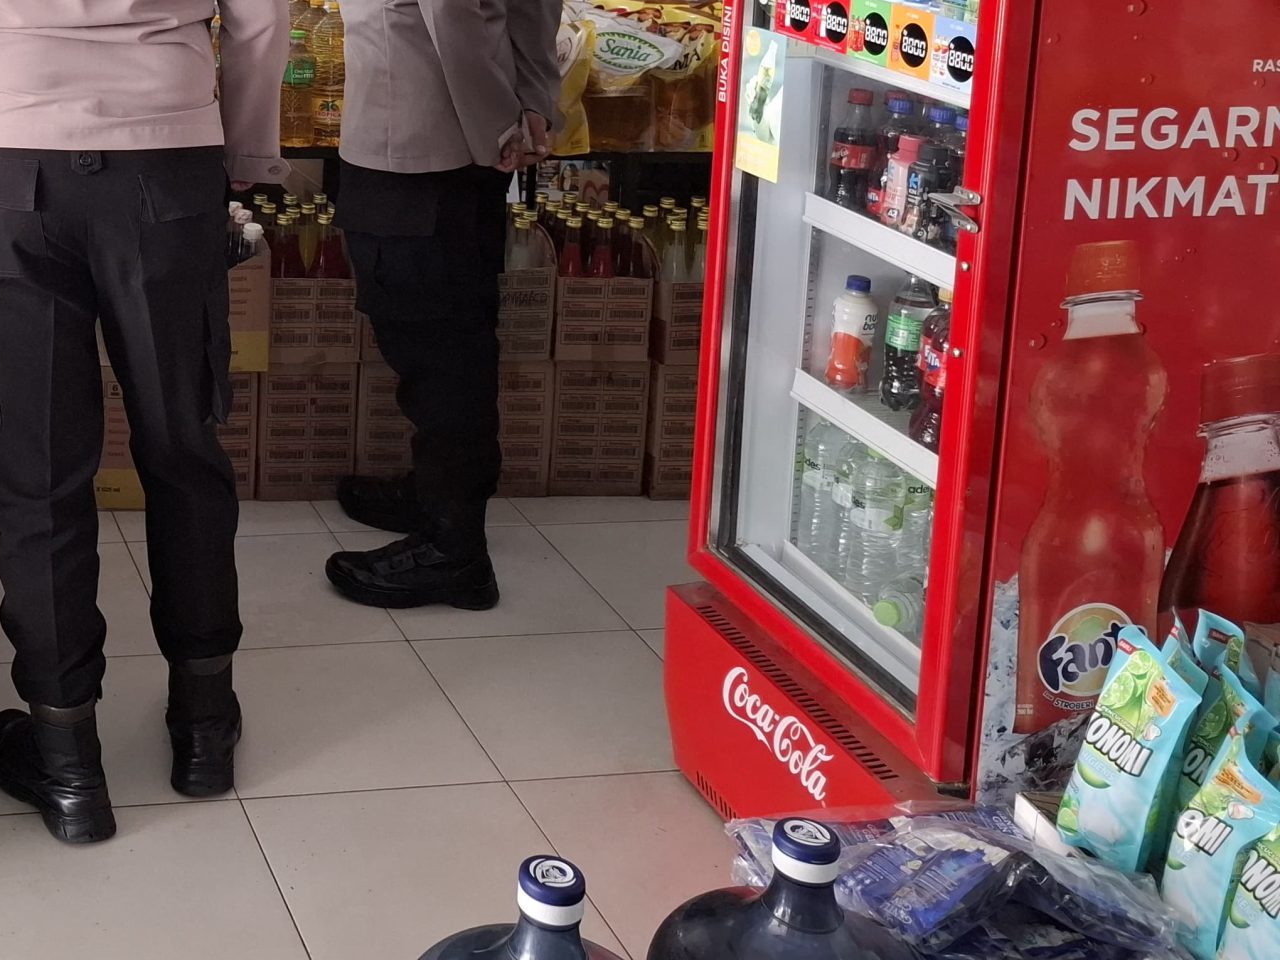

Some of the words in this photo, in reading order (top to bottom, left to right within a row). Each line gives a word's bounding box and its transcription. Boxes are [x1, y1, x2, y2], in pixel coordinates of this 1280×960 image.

[599, 37, 652, 63] Sania
[722, 5, 733, 53] DISINI
[864, 24, 888, 47] 8800
[902, 36, 927, 58] 8800
[718, 58, 730, 102] BUKA
[1063, 174, 1279, 221] NIKMAT
[1039, 622, 1147, 692] Fant
[722, 665, 834, 802] Coca-Cola
